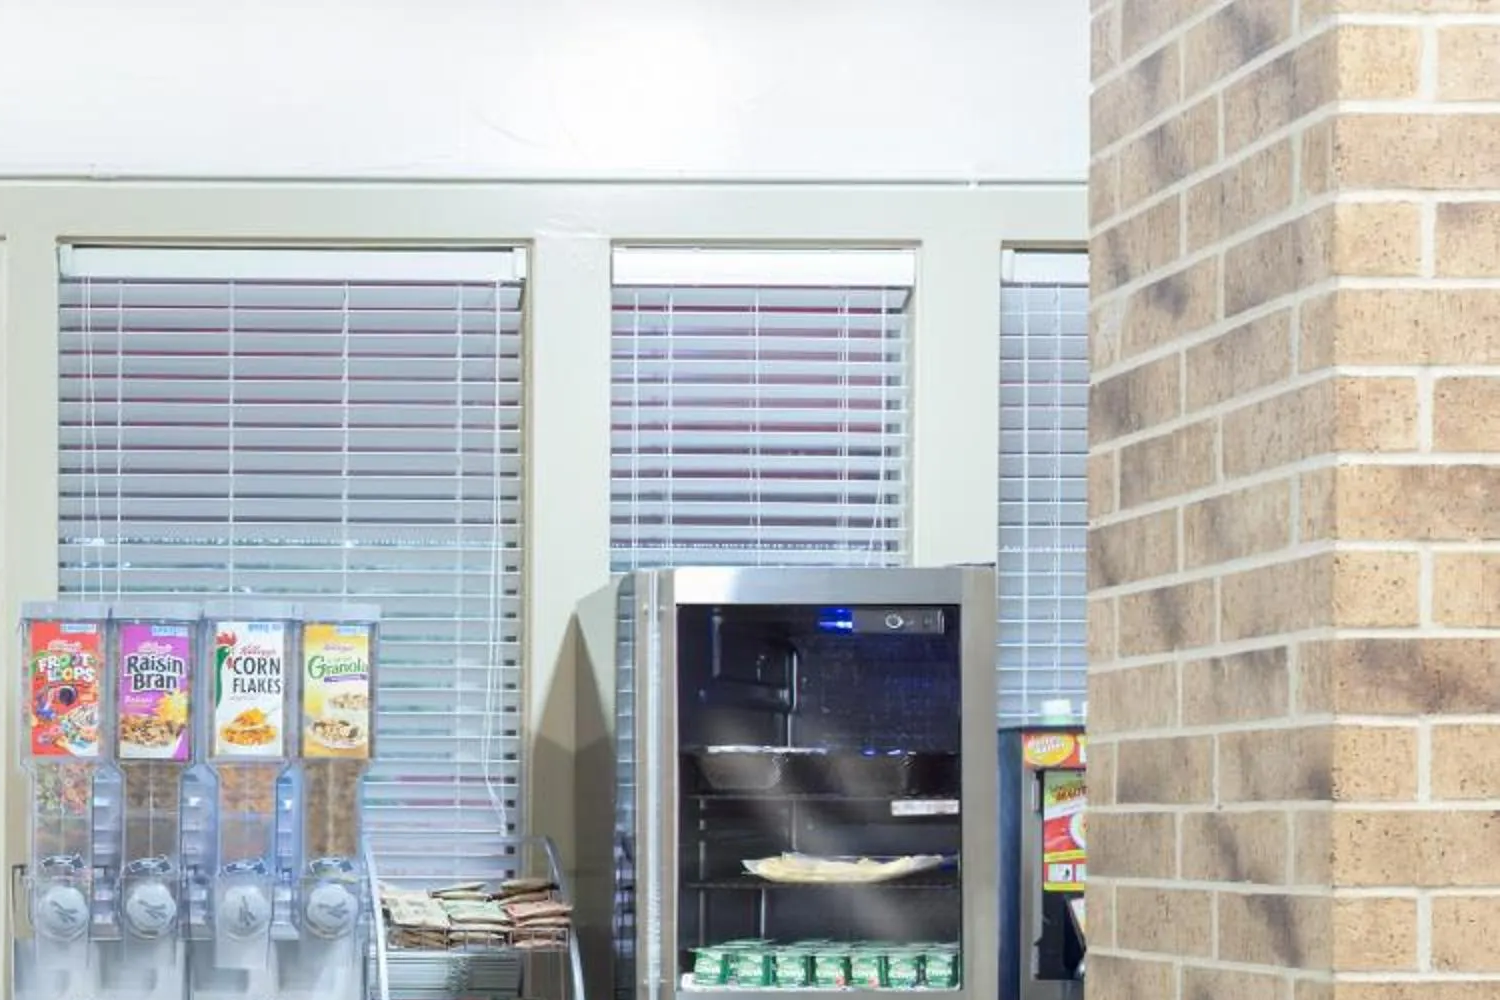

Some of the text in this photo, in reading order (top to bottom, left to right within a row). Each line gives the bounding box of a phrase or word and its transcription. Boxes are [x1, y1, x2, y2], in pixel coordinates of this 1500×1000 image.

[127, 655, 183, 674] Raisin
[233, 656, 281, 675] CORN
[133, 673, 177, 690] Bran
[233, 678, 281, 693] FLAKES
